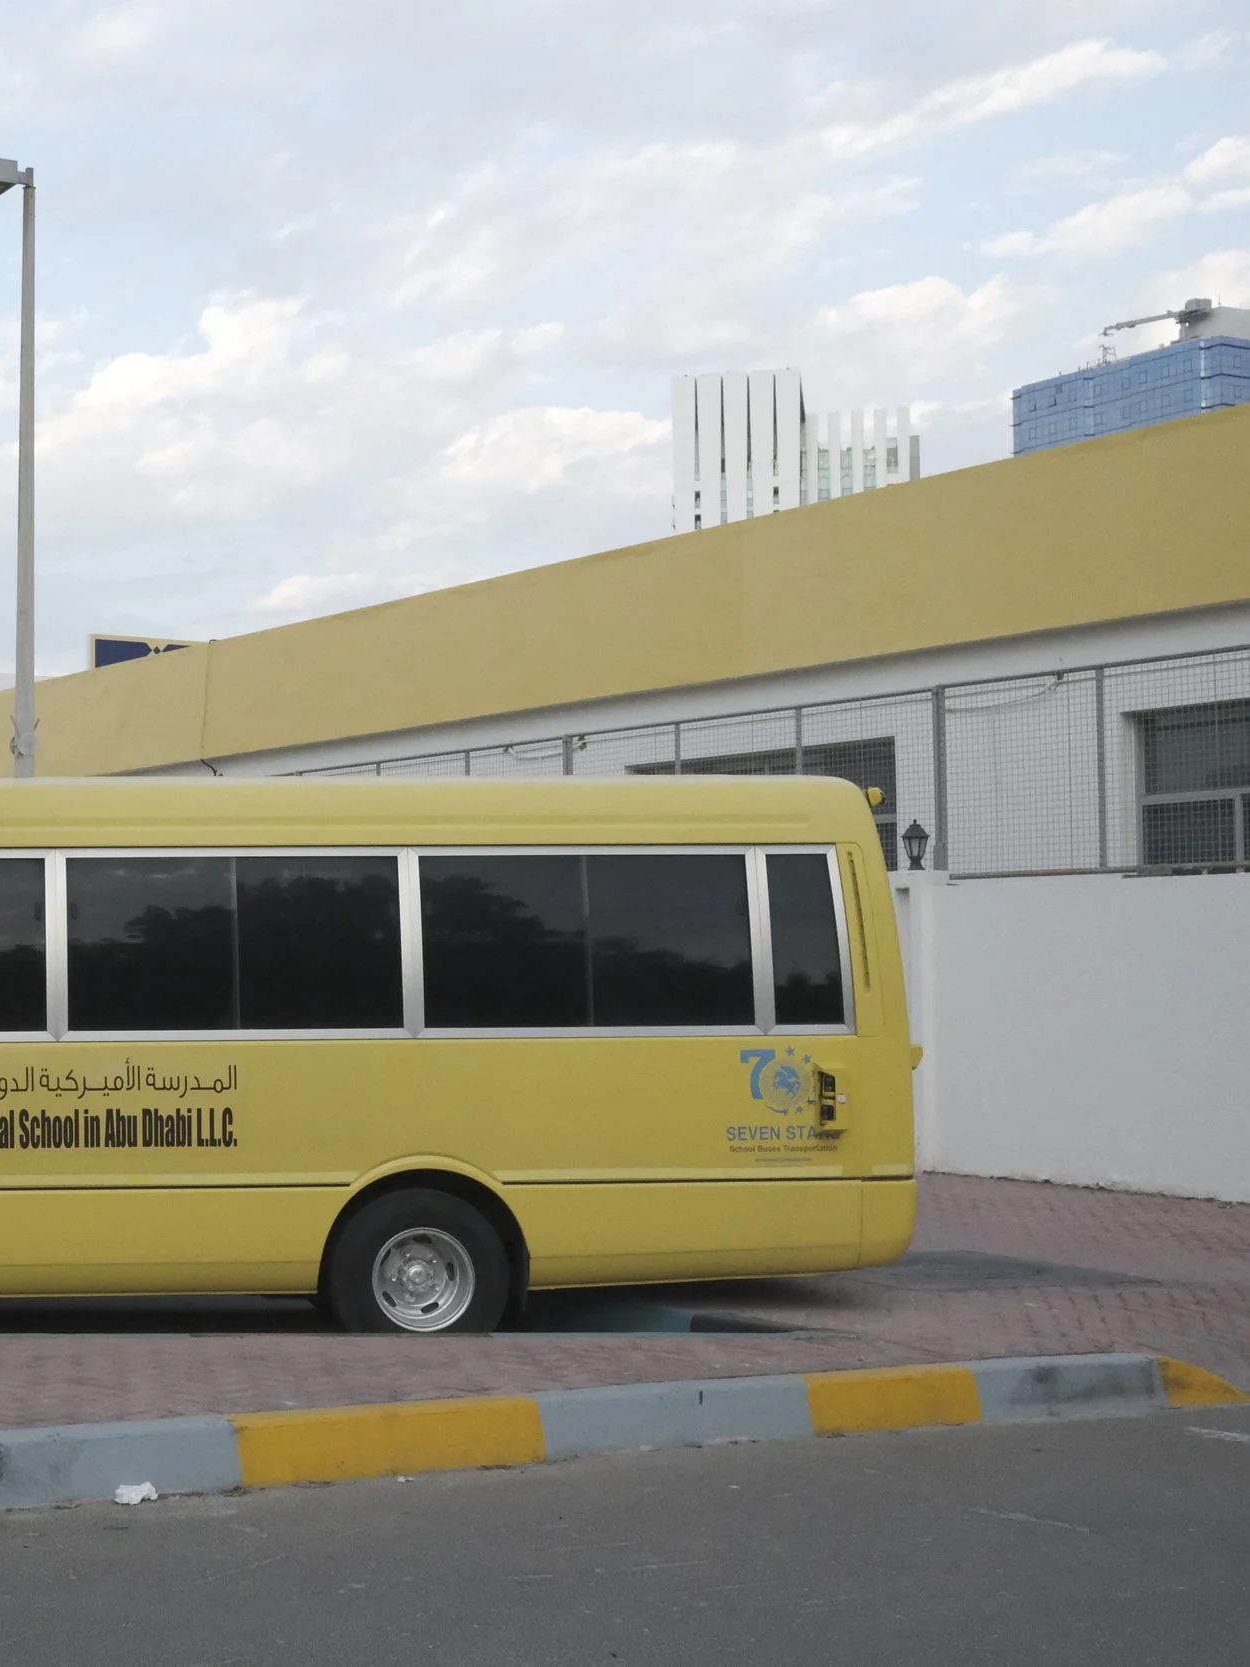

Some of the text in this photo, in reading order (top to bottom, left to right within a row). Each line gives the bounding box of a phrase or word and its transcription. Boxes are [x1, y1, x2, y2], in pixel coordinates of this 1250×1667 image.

[40, 1058, 140, 1099] الأميركية
[146, 1065, 237, 1098] المدرسة
[19, 1108, 79, 1149] School
[84, 1109, 100, 1148] in
[105, 1108, 137, 1147] Abu
[142, 1108, 192, 1147] Dhabi
[197, 1107, 237, 1147] L.L.C.
[726, 1126, 781, 1141] SEVEN
[729, 1144, 838, 1153] School Buses Transportation
